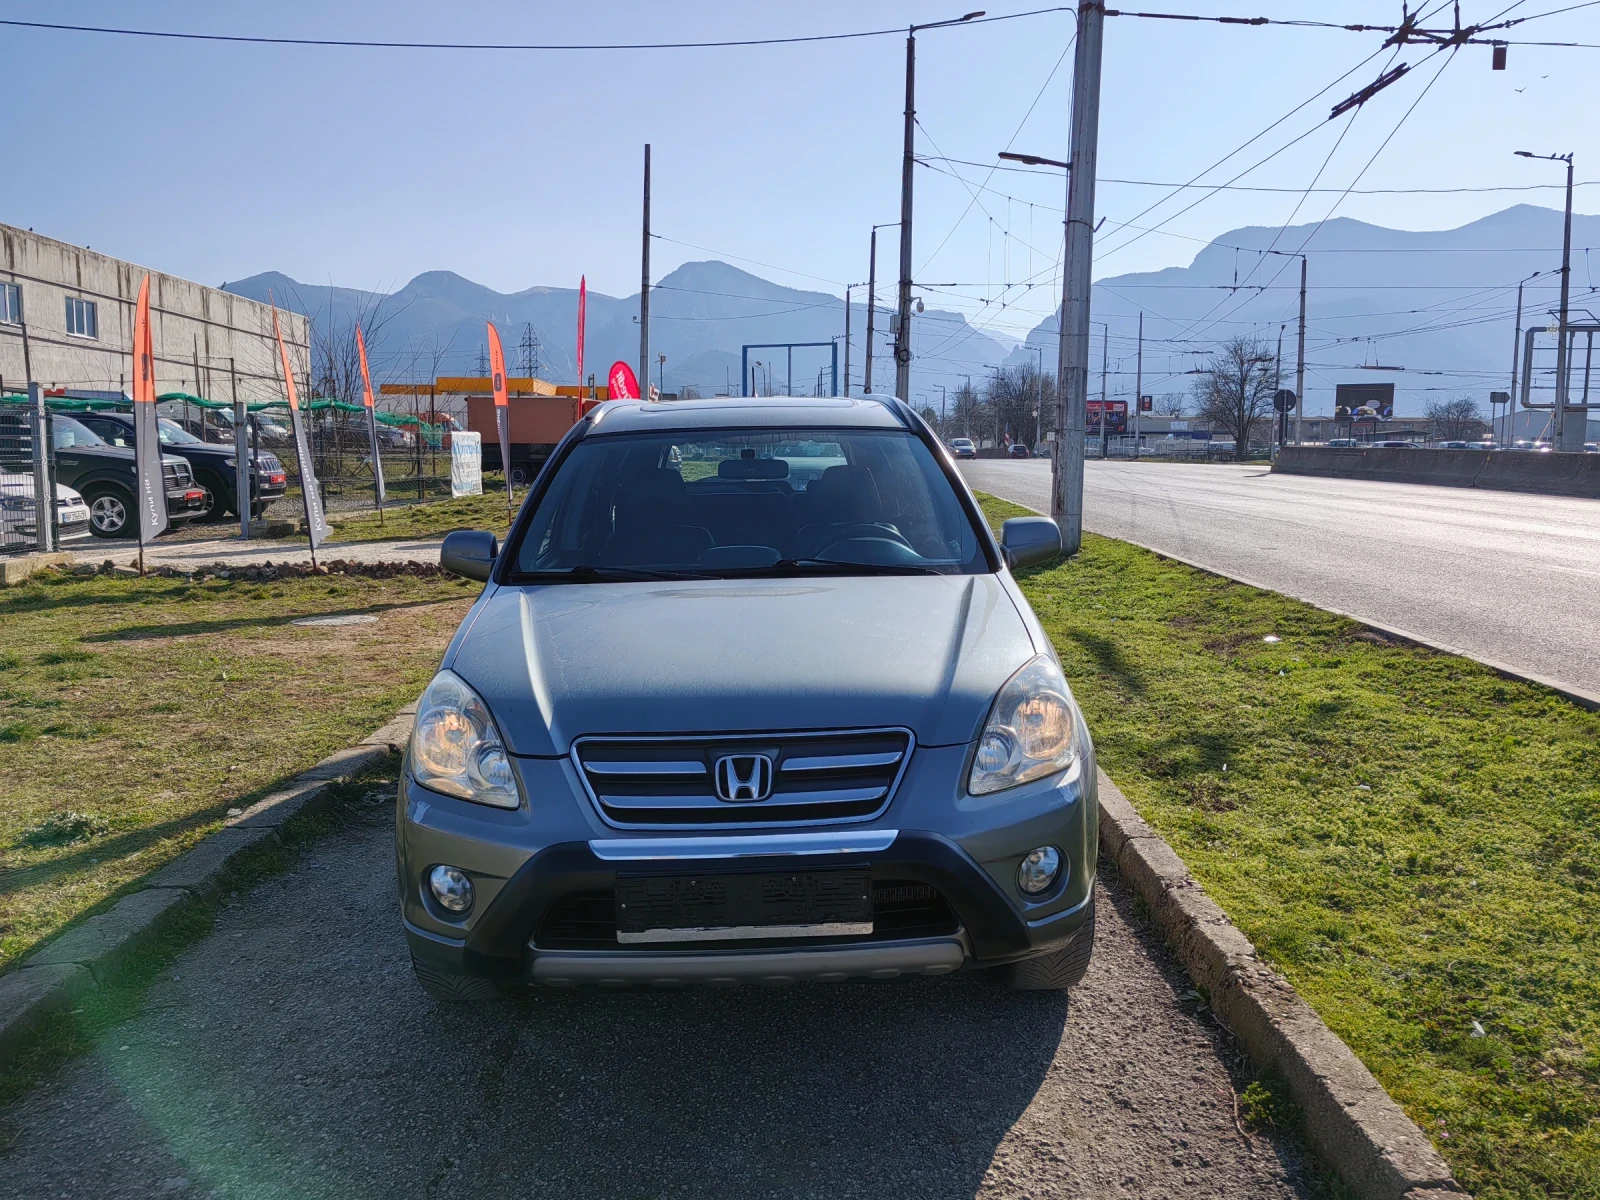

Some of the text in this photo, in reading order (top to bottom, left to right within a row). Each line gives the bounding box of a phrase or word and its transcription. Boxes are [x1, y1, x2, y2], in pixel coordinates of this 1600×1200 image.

[145, 479, 159, 526] Купи на
[308, 484, 316, 499] на
[312, 502, 322, 531] Купи
